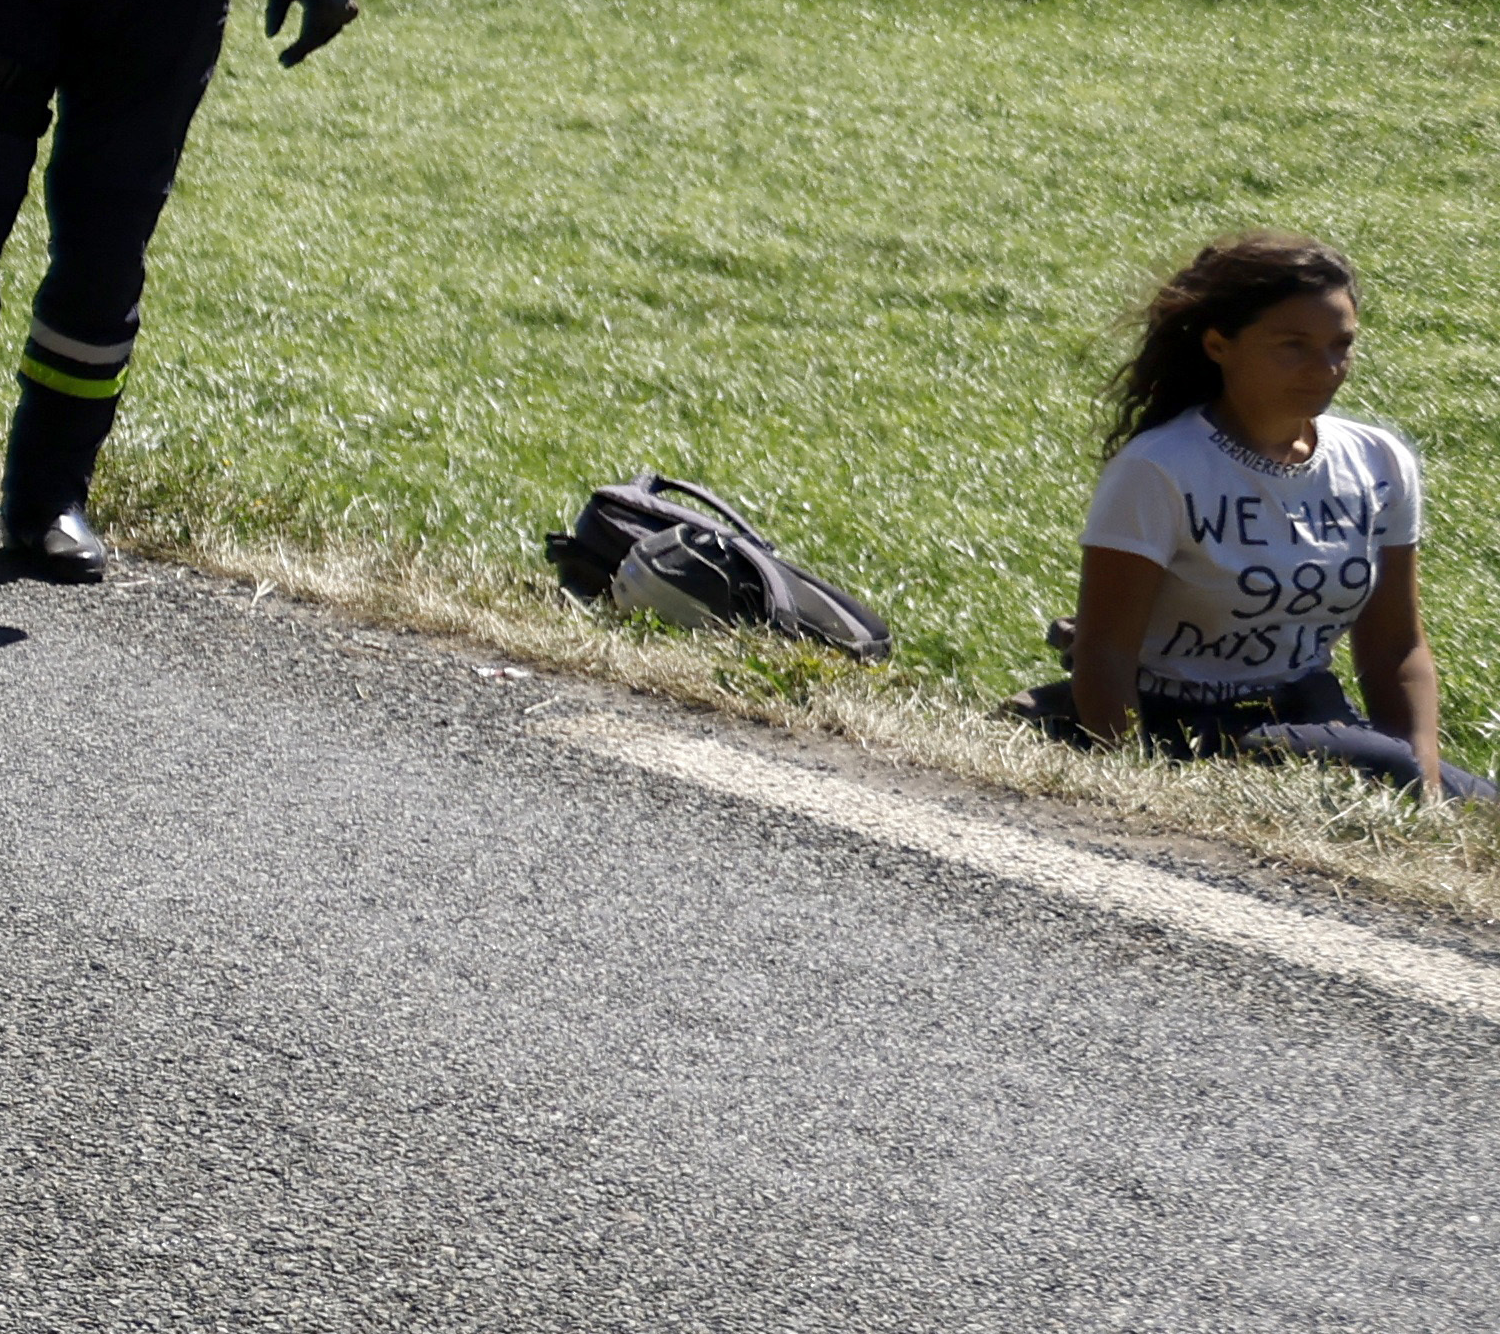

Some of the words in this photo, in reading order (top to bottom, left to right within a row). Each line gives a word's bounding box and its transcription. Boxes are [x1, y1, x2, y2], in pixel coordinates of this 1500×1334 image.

[1184, 492, 1269, 546] WE
[1282, 480, 1389, 546] HAVE
[1230, 556, 1372, 619] 989
